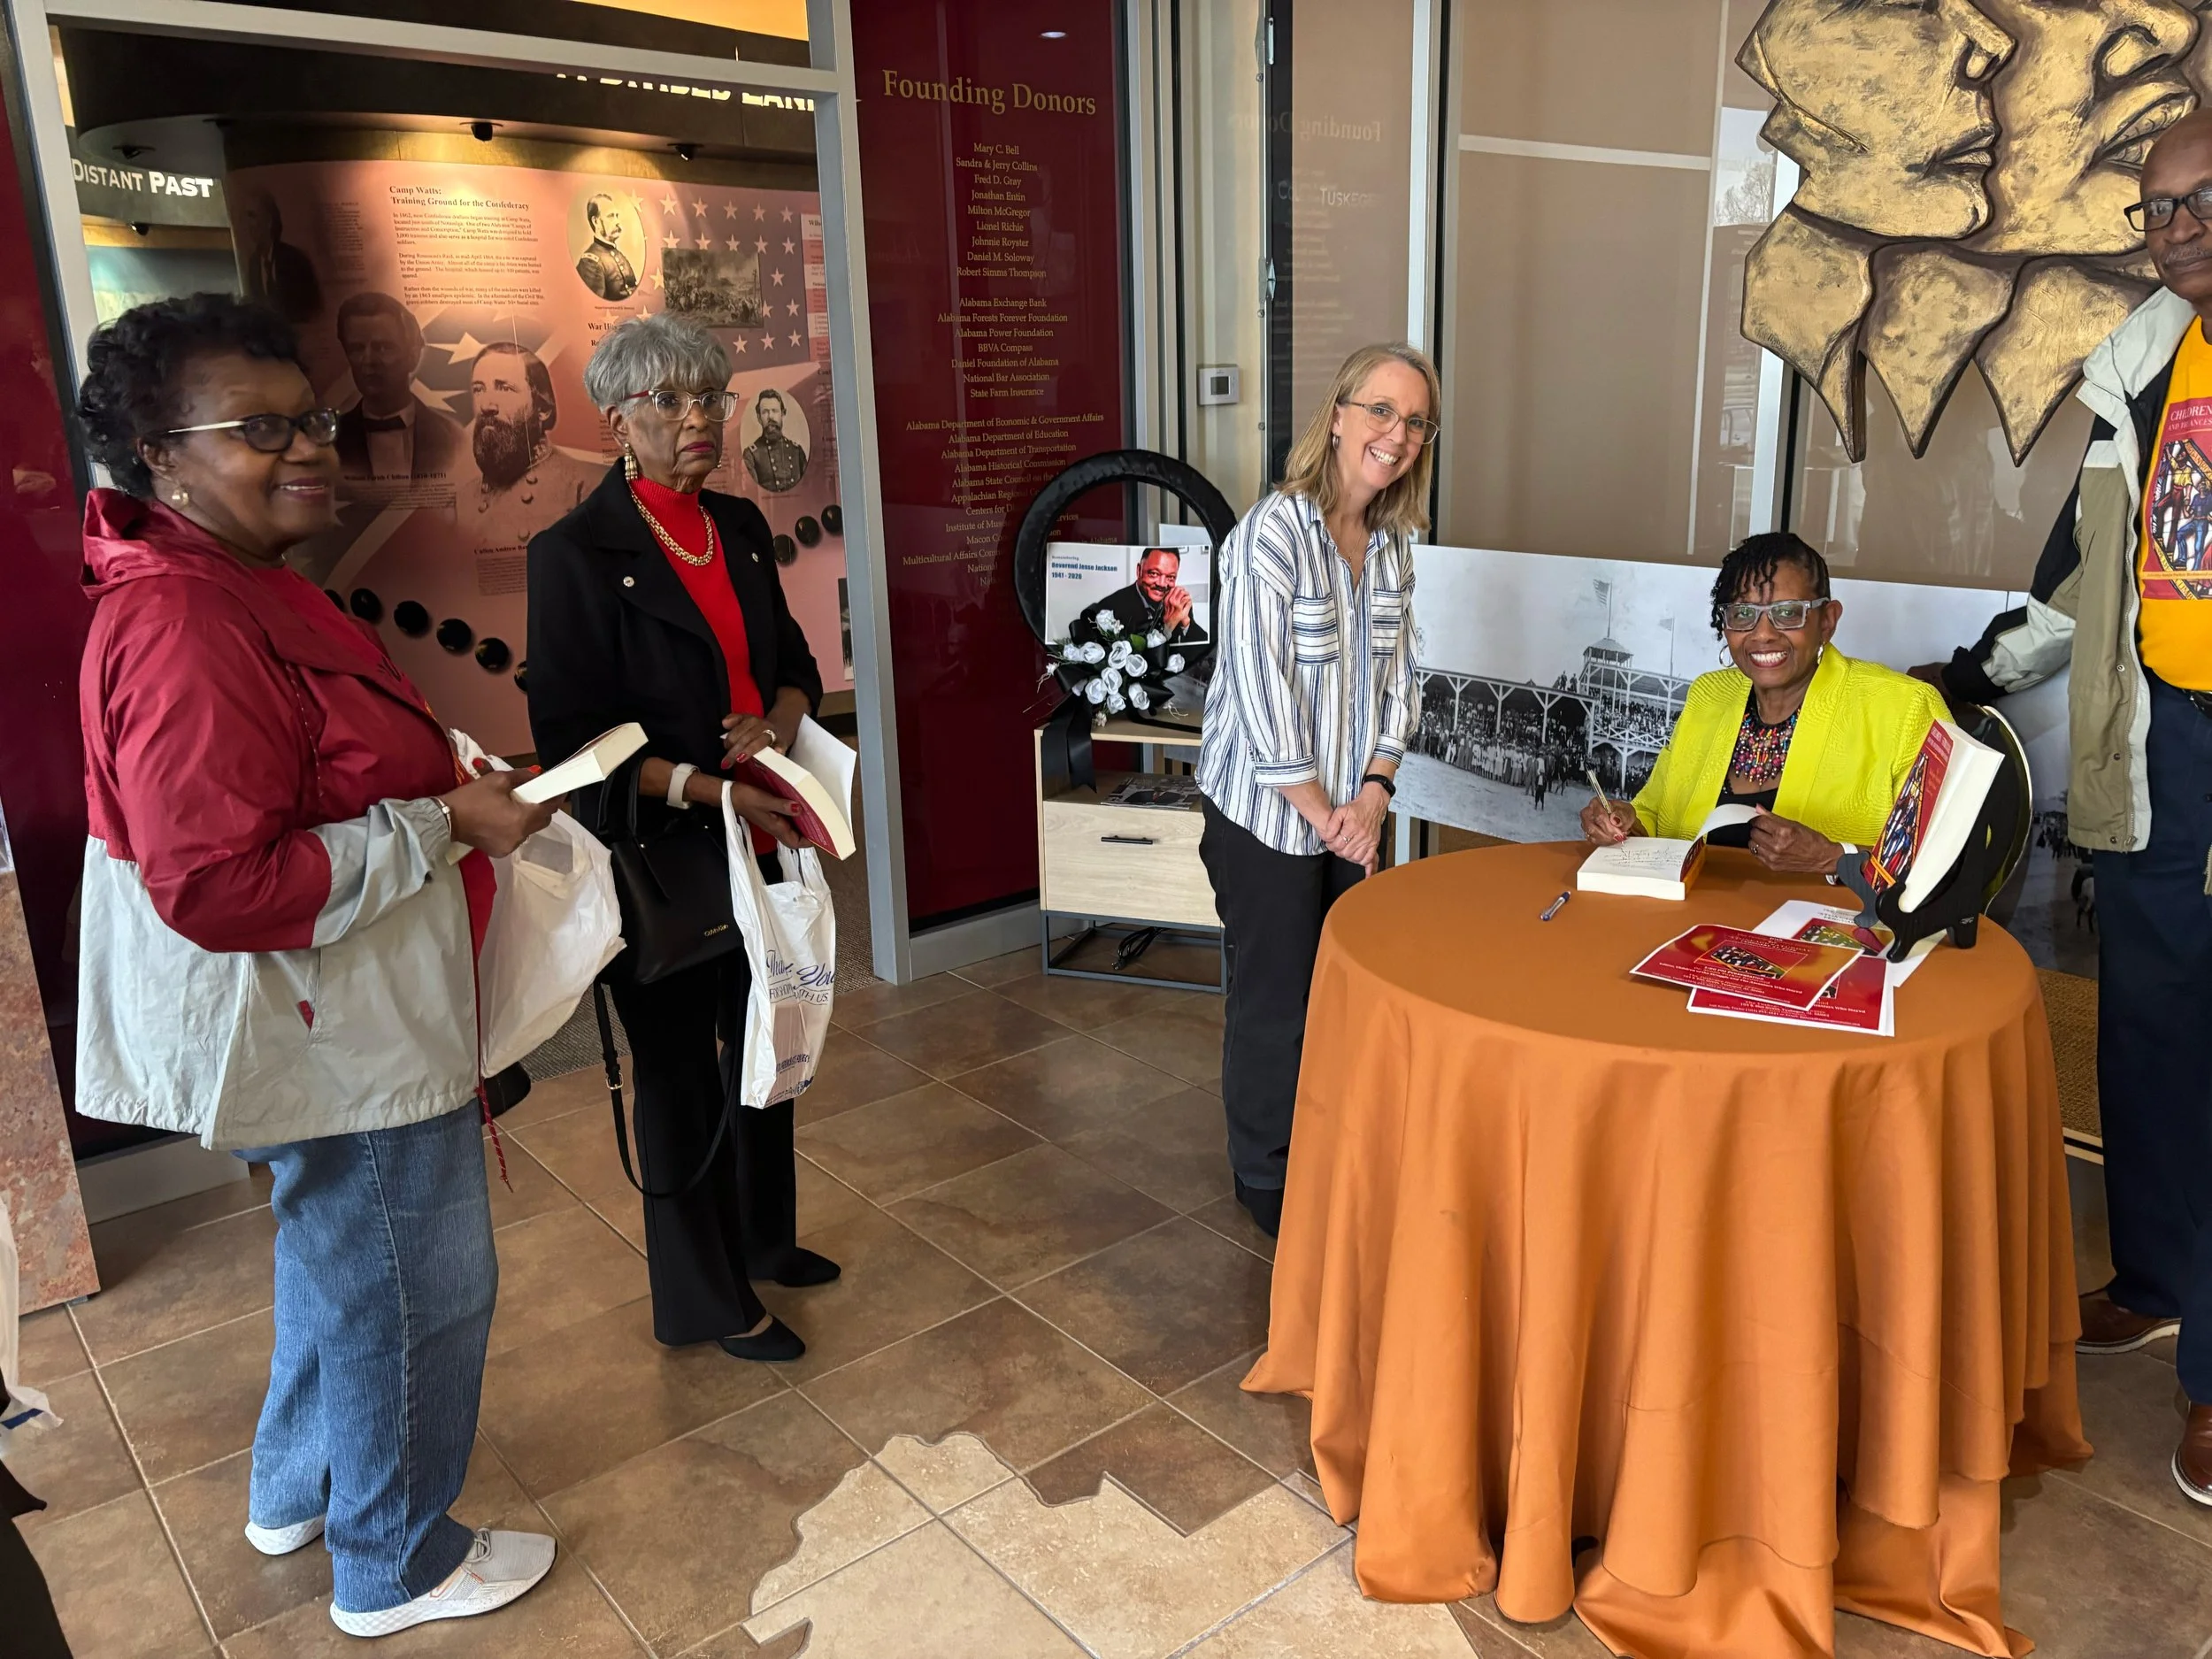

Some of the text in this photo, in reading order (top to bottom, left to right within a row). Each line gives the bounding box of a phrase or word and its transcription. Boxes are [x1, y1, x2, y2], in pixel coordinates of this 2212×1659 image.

[882, 69, 1096, 115] Founding Donors
[974, 143, 1019, 155] Mary C. Bell
[956, 157, 982, 168] Sandra
[993, 160, 1010, 172] Jerry
[1012, 162, 1038, 172] Collins
[71, 158, 214, 198] DISTANT PAST
[974, 174, 1021, 188] Fred D. Gray
[389, 186, 414, 196] Camp
[972, 190, 1025, 201] Jonathan Entin
[391, 196, 426, 205] Training
[486, 200, 529, 211] Confederacy
[968, 205, 1031, 218] Milton McGregor
[977, 221, 1024, 232] Lionel Richie
[972, 236, 1029, 248] Johnnie Royster
[967, 252, 991, 261] Daniel
[1004, 253, 1034, 265] Soloway
[956, 267, 1047, 280] Robert Simms Thompson
[960, 298, 1047, 310] Alabama Exchange Bank
[938, 313, 1067, 322] Alabama Forests Forever Foundation
[1014, 328, 1054, 337] Foundation
[1001, 344, 1033, 354] Compass
[952, 359, 976, 368] Daniel
[1028, 357, 1058, 366] Alabama
[964, 373, 995, 382] National
[1010, 373, 1049, 381] Association
[906, 421, 940, 431] Alabama
[941, 419, 985, 430] Department
[987, 418, 995, 426] of
[996, 417, 1030, 426] Economic
[1039, 415, 1080, 424] Government
[1082, 413, 1103, 422] Affairs
[949, 434, 980, 444] Alabama
[982, 432, 1025, 443] Department
[941, 443, 1076, 459] Alabama Department of Transportation
[955, 458, 1065, 472] Alabama Historical Commission
[952, 479, 984, 488] Alabama
[986, 477, 1002, 486] State
[1004, 474, 1031, 484] Council
[951, 492, 996, 504] Appalachian
[966, 506, 993, 516] Centers
[995, 505, 1005, 514] for
[946, 523, 976, 533] Institute
[967, 534, 991, 544] Macon
[902, 553, 952, 565] Multicultural
[954, 550, 978, 560] Affairs
